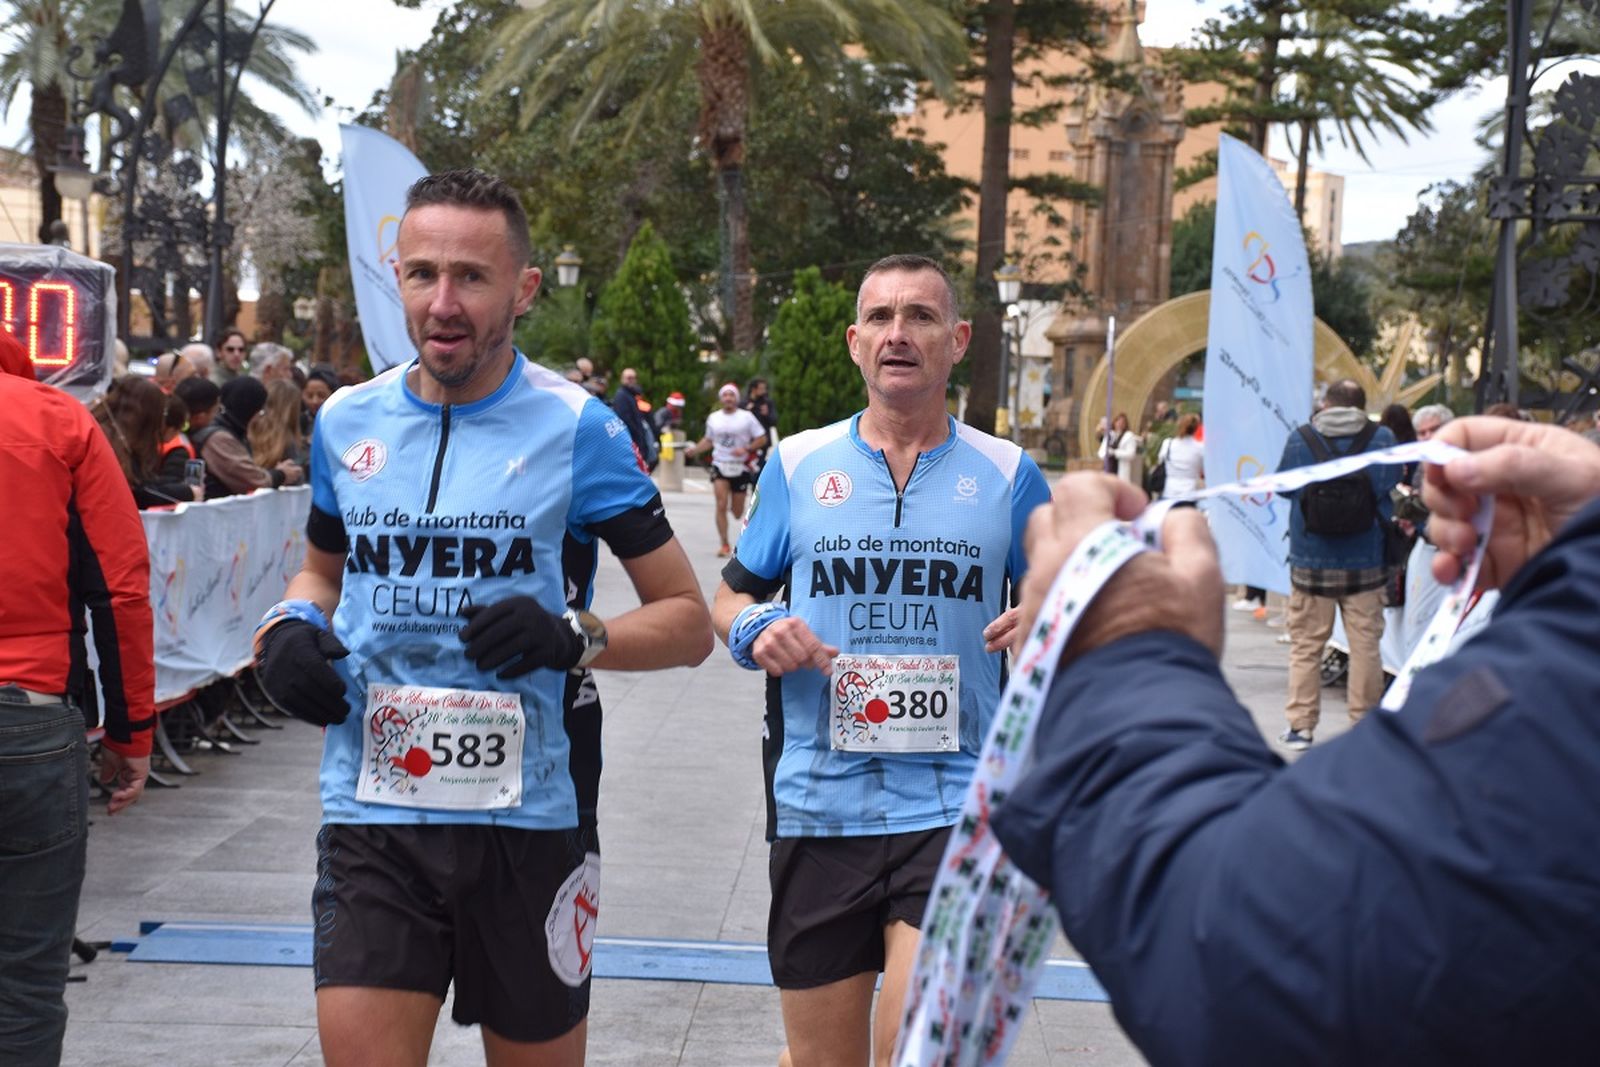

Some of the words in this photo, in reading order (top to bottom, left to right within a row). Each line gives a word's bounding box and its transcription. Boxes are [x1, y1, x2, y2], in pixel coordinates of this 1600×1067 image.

[383, 507, 410, 529] de
[416, 508, 527, 531] montaña
[813, 534, 852, 554] club
[857, 535, 884, 553] de
[889, 536, 981, 559] montaña
[809, 556, 984, 602] ANYERA
[372, 583, 474, 618] CEUTA
[372, 620, 470, 635] www.clubanyera.e
[848, 602, 939, 632] CEUTA
[849, 633, 938, 648] www.clubanyera.es
[888, 690, 948, 720] 380
[431, 731, 507, 768] 583
